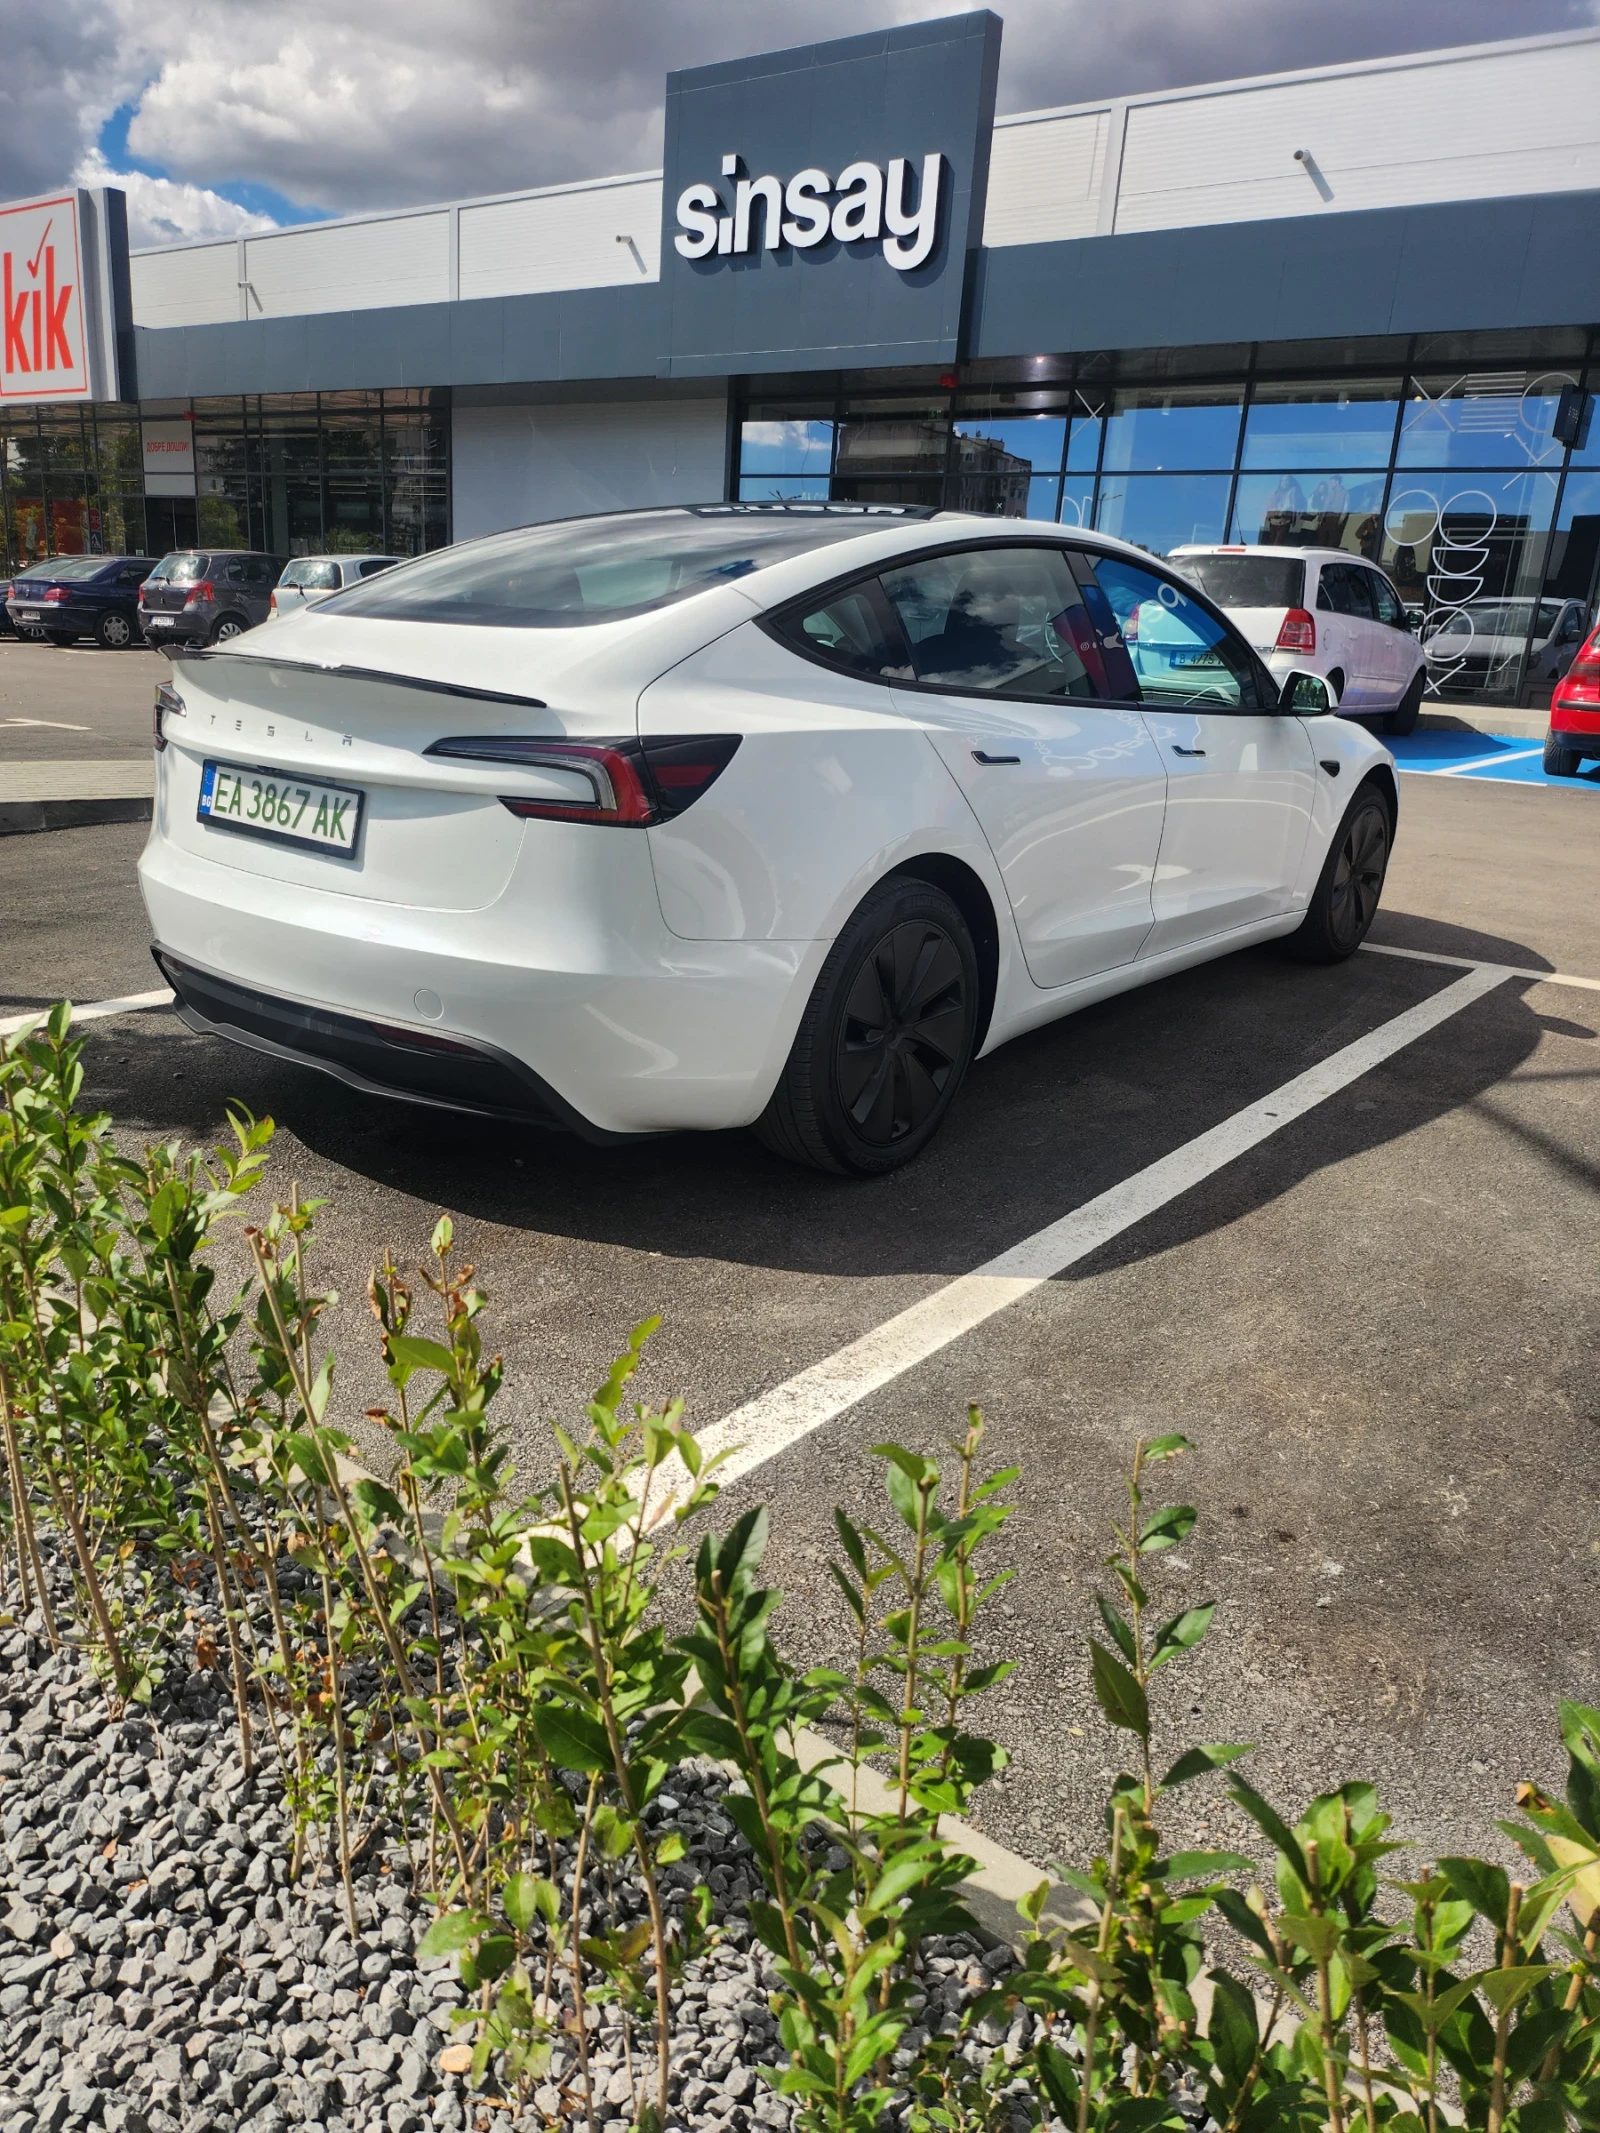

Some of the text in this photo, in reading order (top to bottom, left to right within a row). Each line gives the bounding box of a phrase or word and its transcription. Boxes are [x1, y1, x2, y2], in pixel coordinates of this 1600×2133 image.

[674, 153, 942, 270] sinsay
[3, 218, 74, 374] kik
[1179, 653, 1186, 664] B
[1191, 654, 1214, 665] 4775
[210, 715, 352, 747] TESLA
[202, 795, 212, 808] BG
[214, 773, 352, 841] EA 3867 AK
